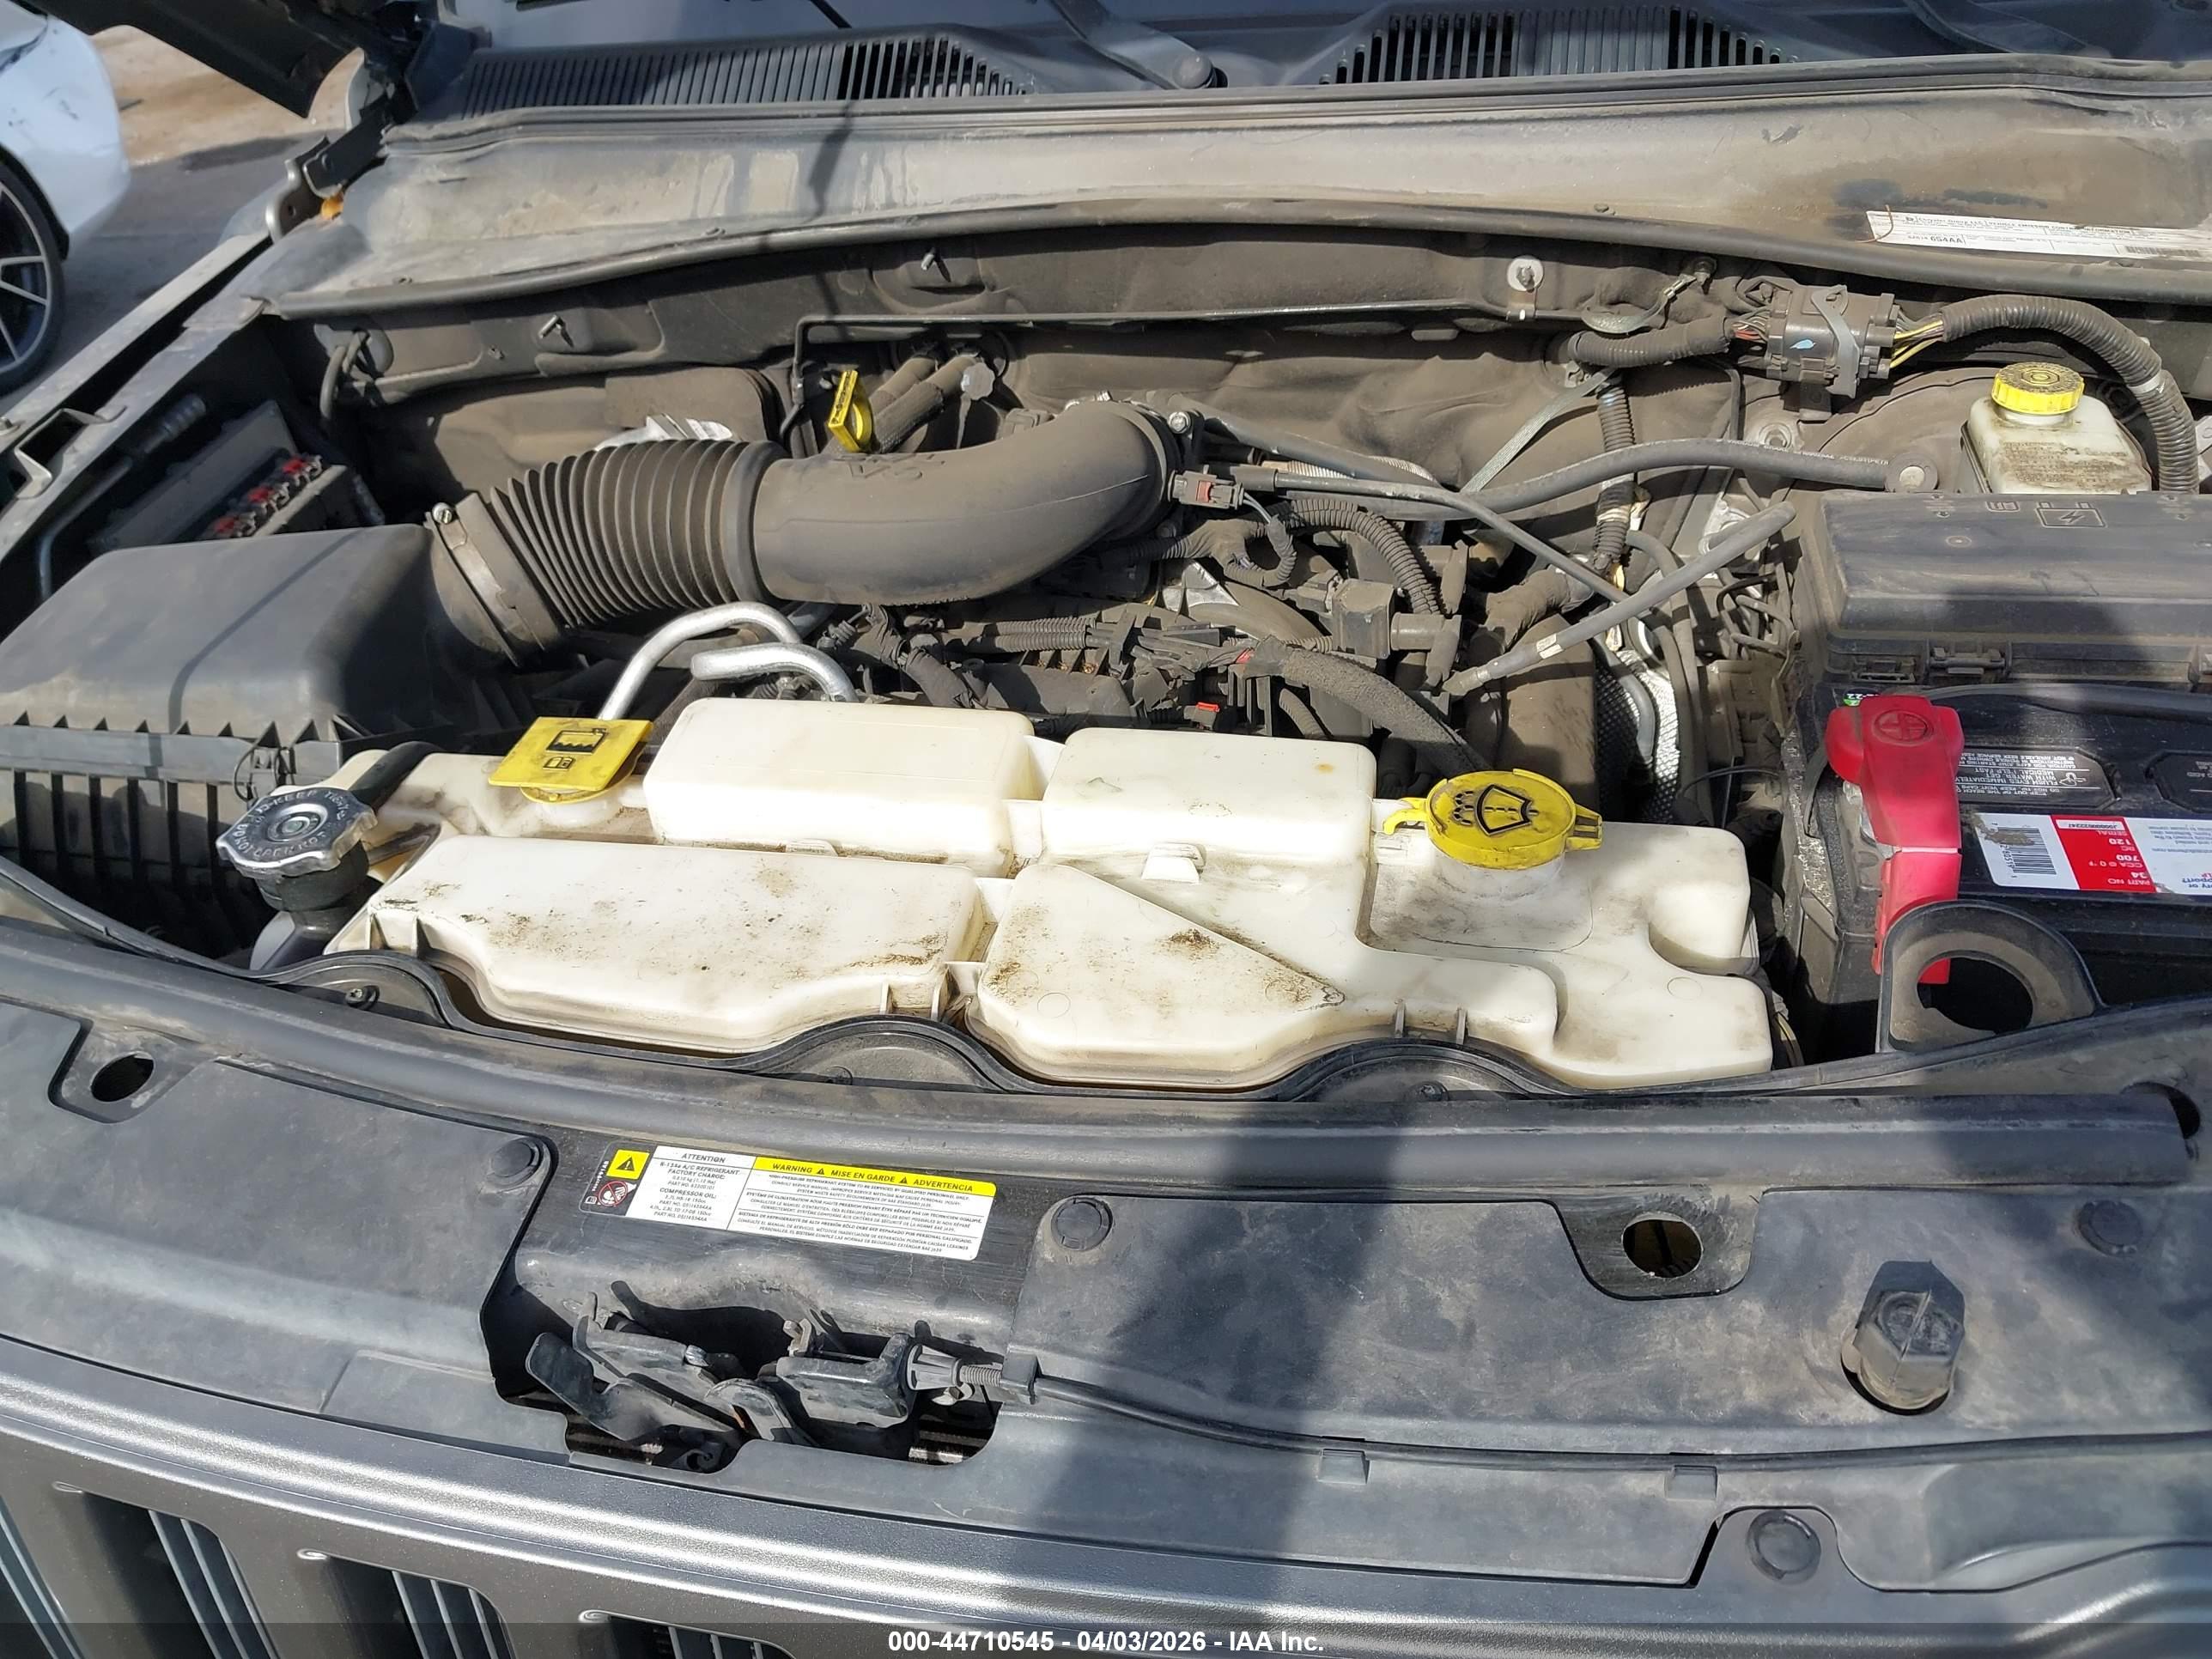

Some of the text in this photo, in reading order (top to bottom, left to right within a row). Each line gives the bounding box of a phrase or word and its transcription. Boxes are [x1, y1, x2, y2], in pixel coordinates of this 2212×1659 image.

[682, 1152, 725, 1163] ATTENTION
[696, 1165, 739, 1175] REFRIGERANT
[771, 1163, 812, 1173] WARNING
[913, 1179, 974, 1191] ADVERTENCIA
[659, 1188, 702, 1197] COMPRESSOR
